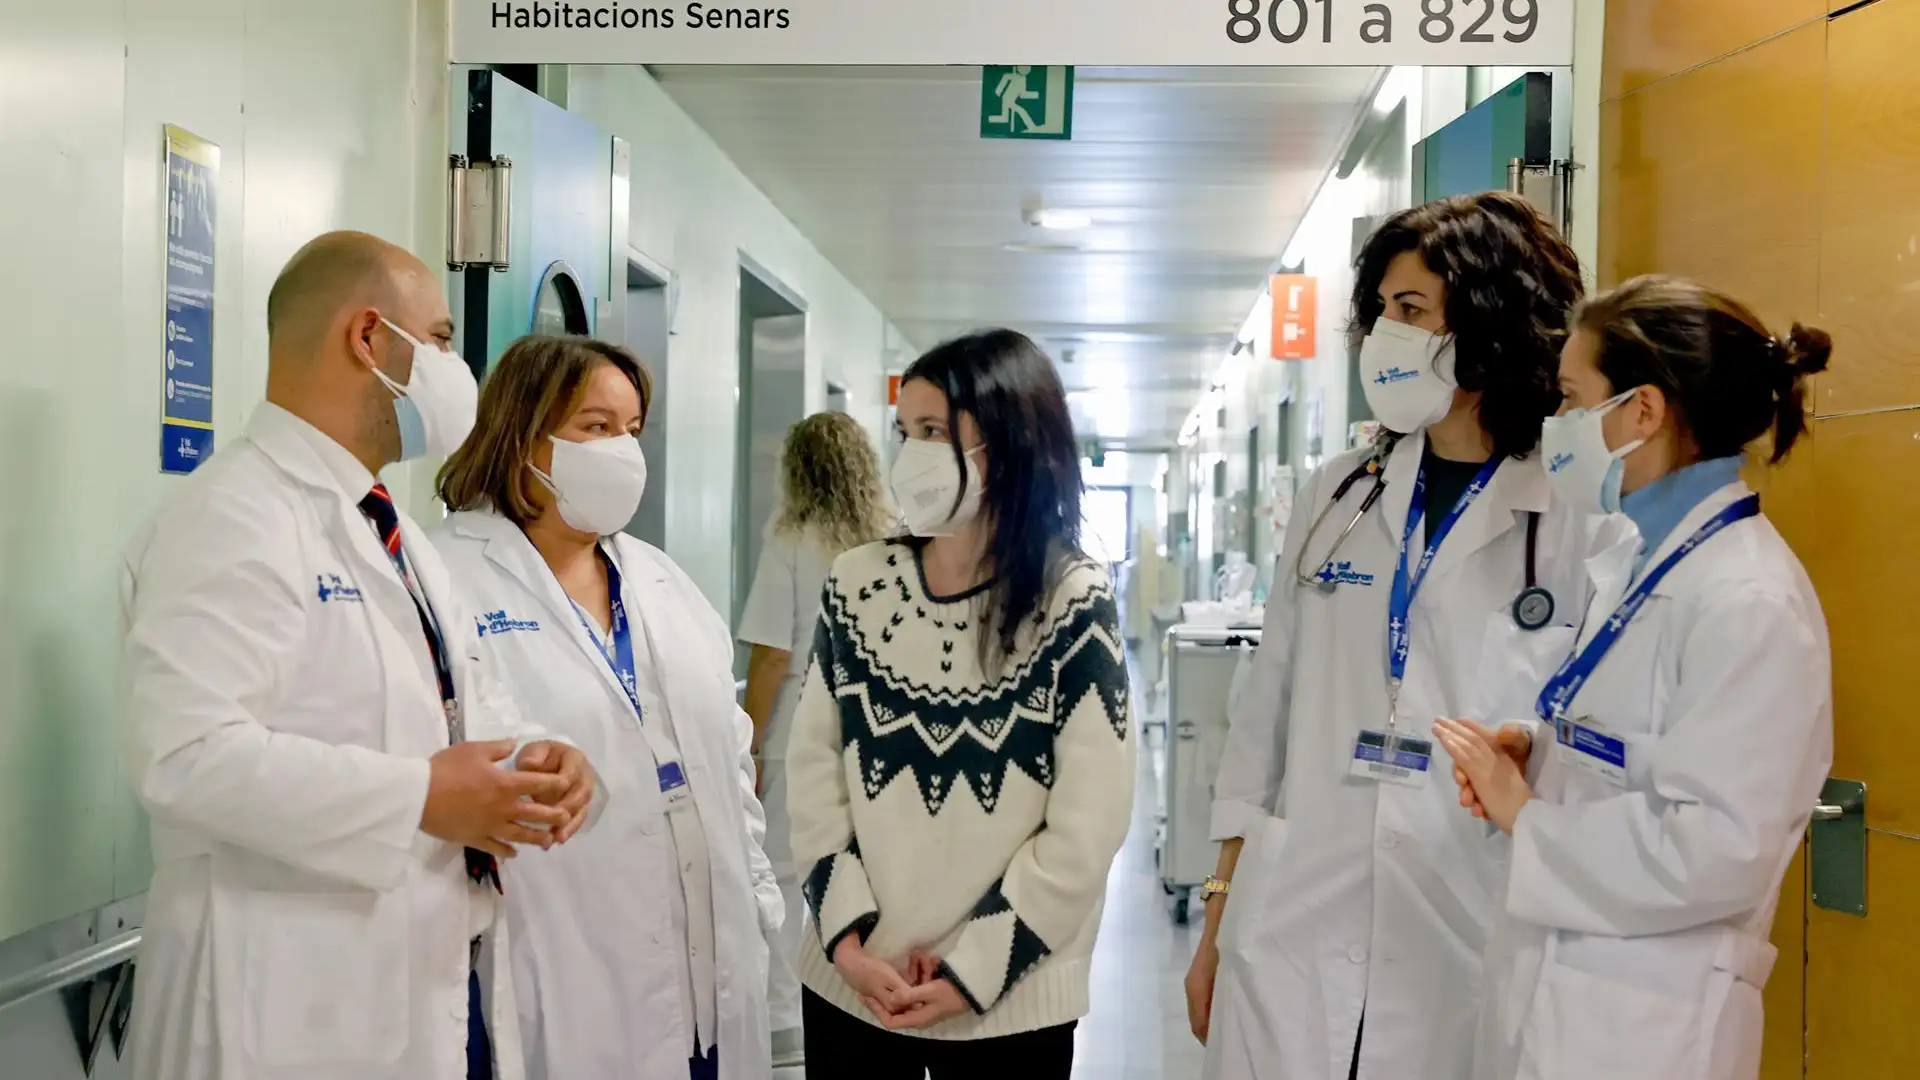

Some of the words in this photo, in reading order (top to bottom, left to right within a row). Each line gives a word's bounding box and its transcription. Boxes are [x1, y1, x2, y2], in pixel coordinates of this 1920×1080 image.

[492, 1, 674, 28] Habitacions
[686, 2, 790, 29] Senars
[1226, 0, 1331, 44] 801
[1359, 3, 1392, 44] a
[1418, 0, 1538, 44] 829
